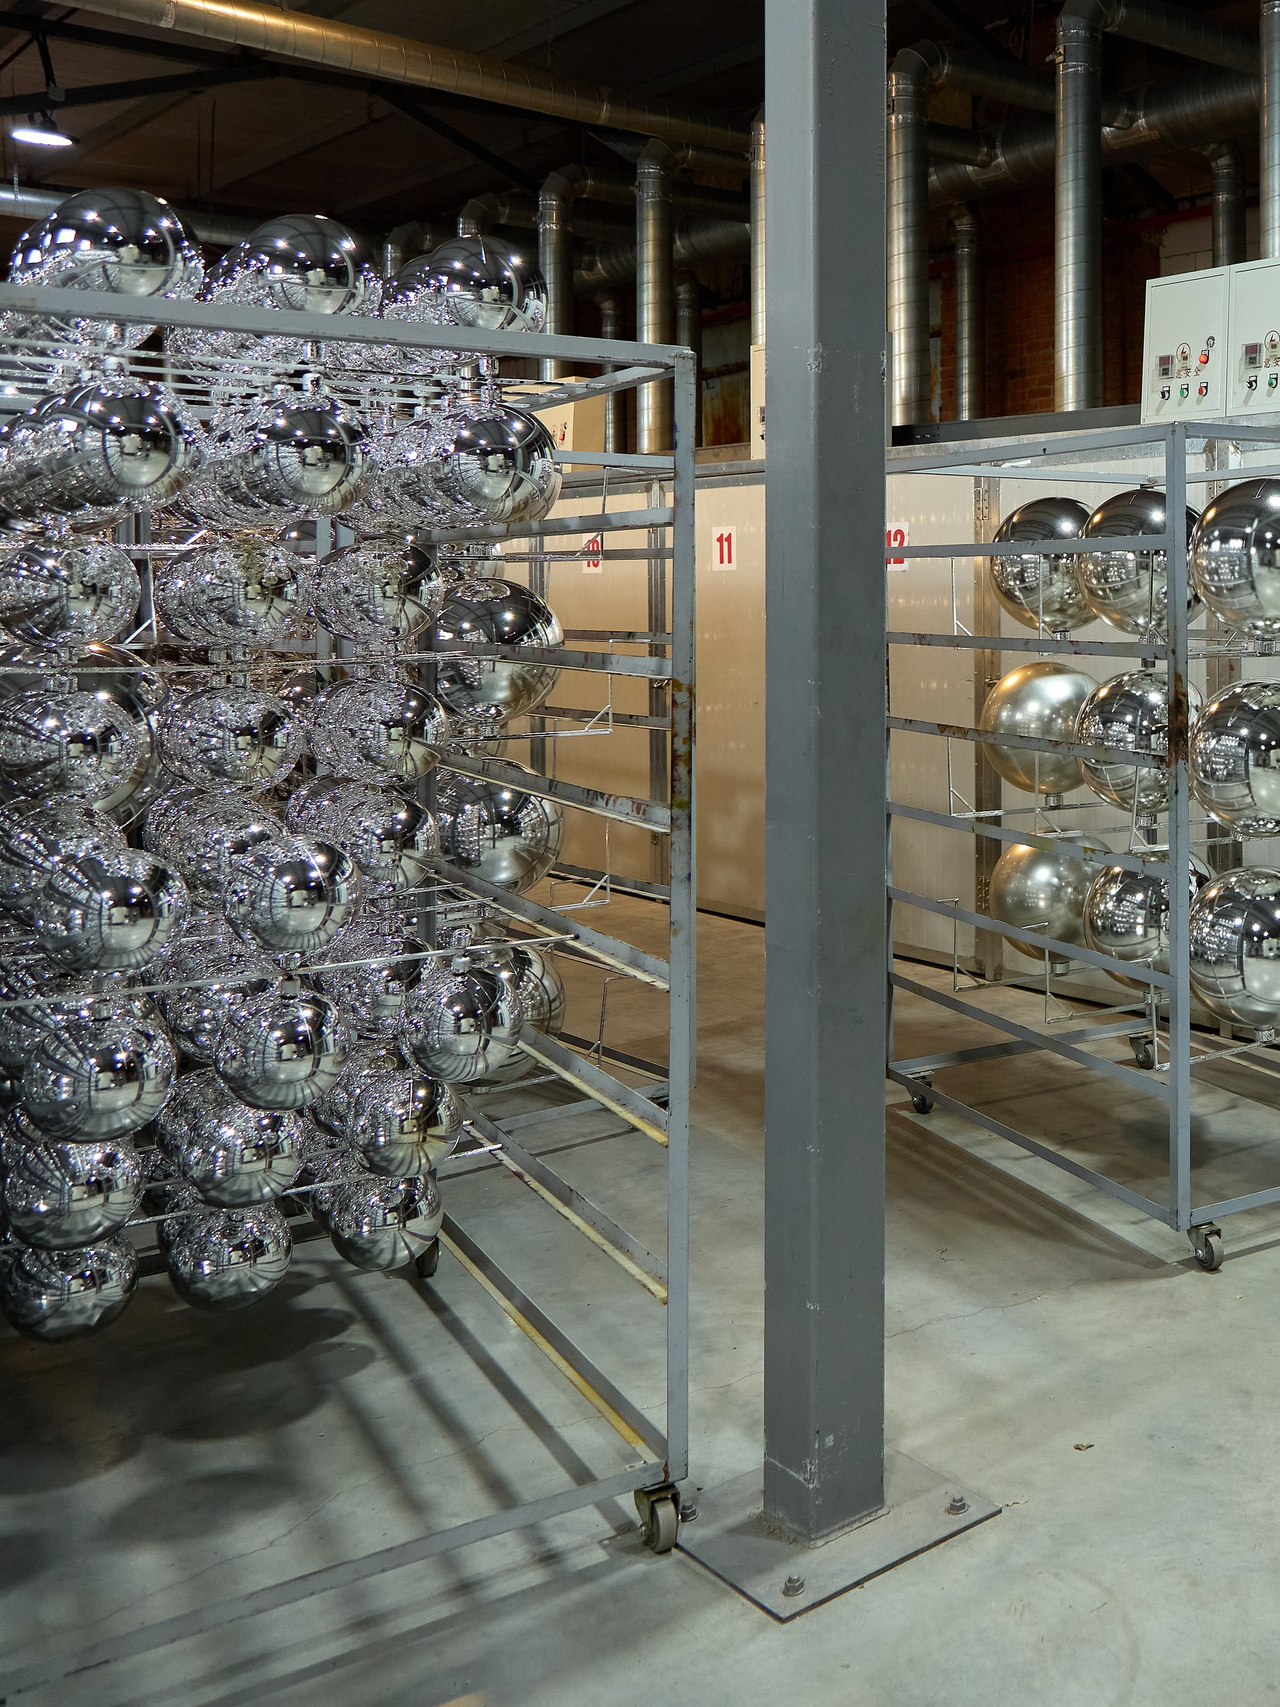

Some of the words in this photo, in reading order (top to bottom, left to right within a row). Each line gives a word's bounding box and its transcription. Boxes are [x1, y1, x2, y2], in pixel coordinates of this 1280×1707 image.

[585, 539, 600, 568] 10
[716, 532, 732, 564] 11
[885, 528, 905, 565] 12
